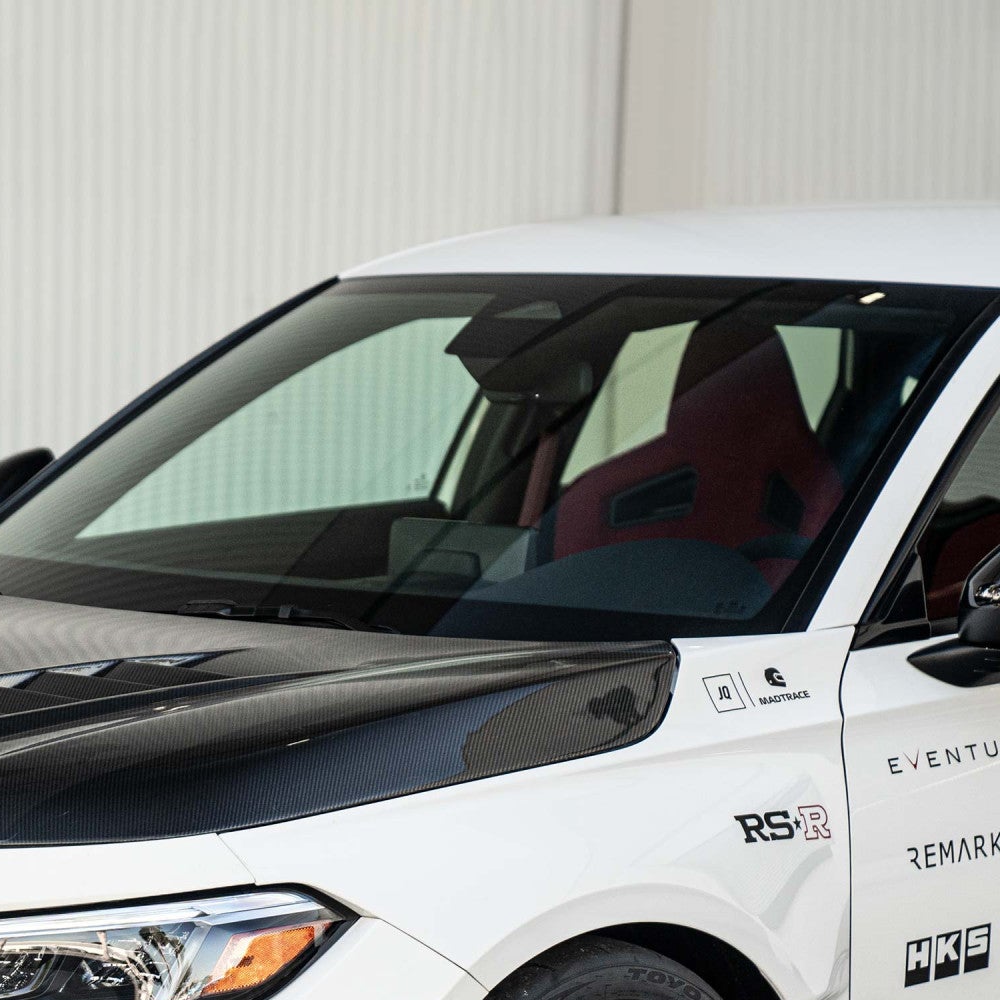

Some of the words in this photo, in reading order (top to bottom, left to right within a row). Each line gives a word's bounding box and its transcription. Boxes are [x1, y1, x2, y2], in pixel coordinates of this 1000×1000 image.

[717, 685, 732, 701] JQ
[758, 689, 811, 706] MADTRACE
[887, 740, 999, 775] EVENTU
[906, 831, 1000, 870] REMARK
[904, 922, 992, 988] HKS
[627, 967, 702, 1000] TOYO
